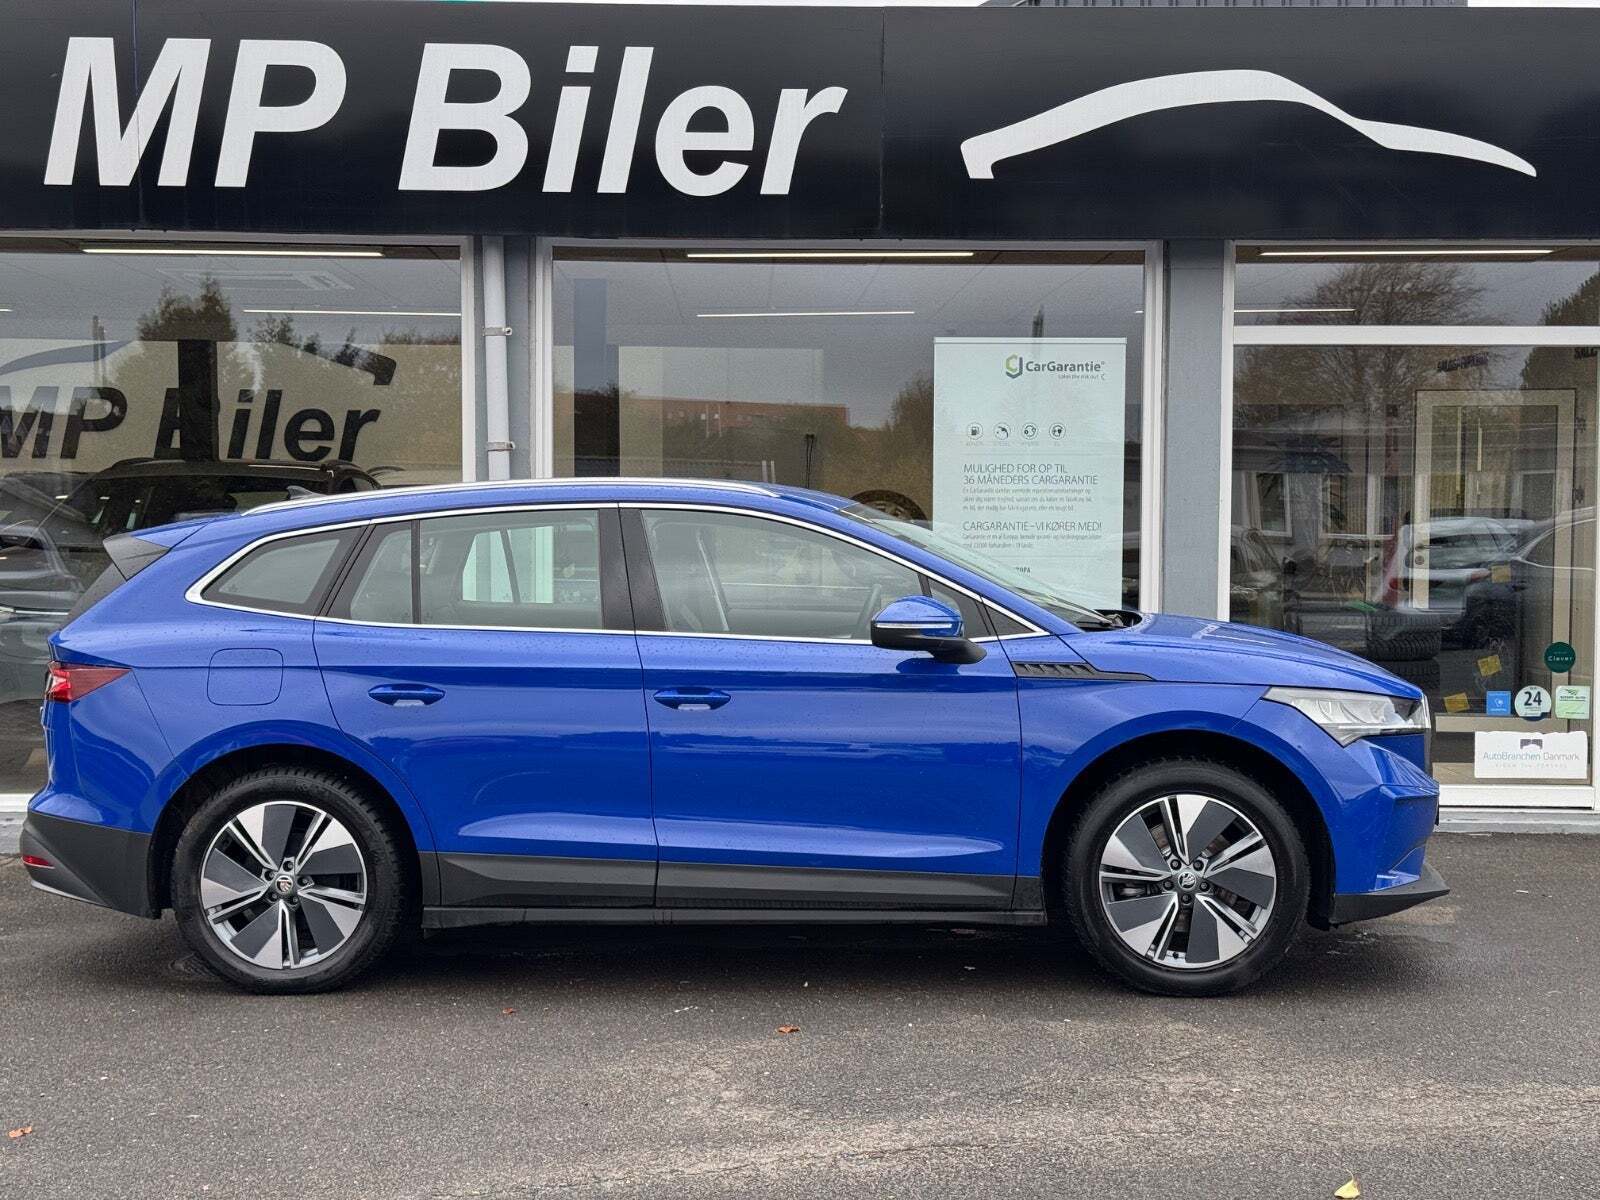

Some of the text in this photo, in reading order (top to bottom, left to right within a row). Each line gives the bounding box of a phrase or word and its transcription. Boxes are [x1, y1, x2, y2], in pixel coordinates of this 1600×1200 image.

[43, 36, 848, 196] MP Biler
[963, 463, 1068, 474] MULIGHED FOR OP TIL
[963, 474, 1099, 485] 36 MÅNEDERS CARGARANTIE
[1045, 521, 1076, 532] KØRER
[1078, 521, 1102, 532] MED!
[1523, 691, 1543, 707] 24
[1482, 750, 1580, 761] AutoBranchen Danmark
